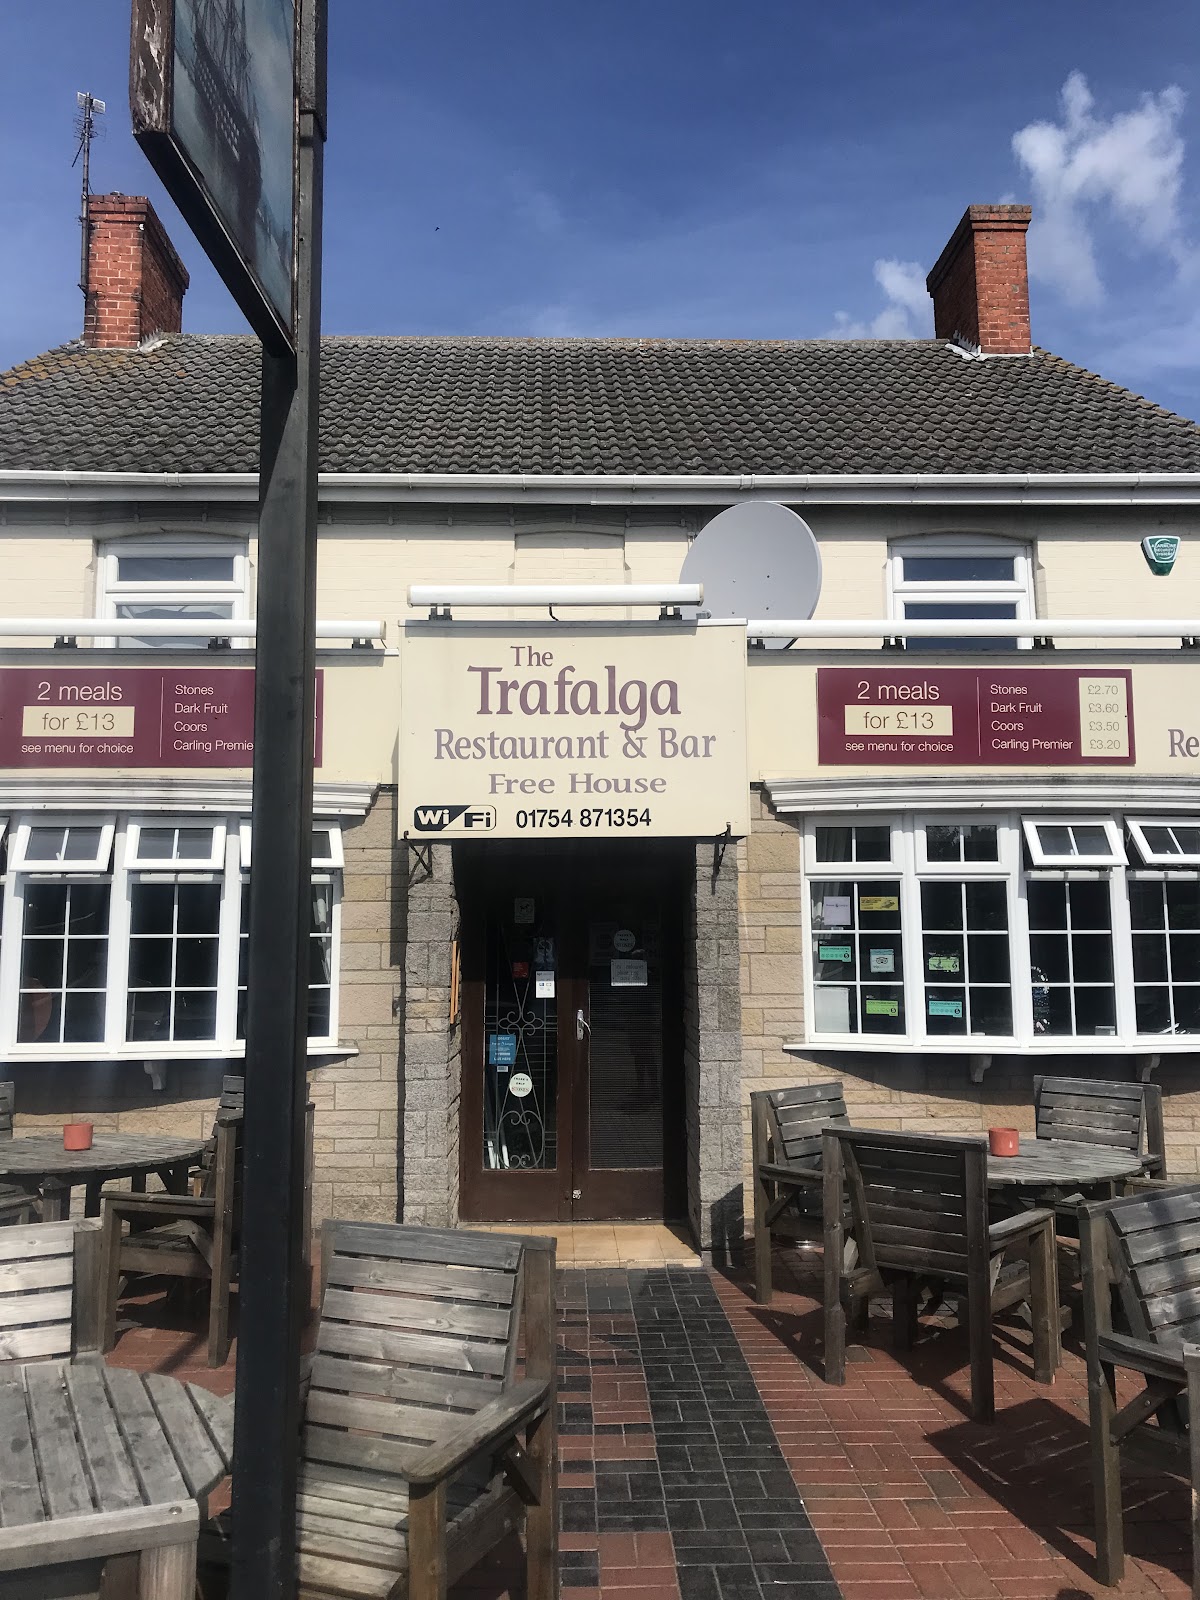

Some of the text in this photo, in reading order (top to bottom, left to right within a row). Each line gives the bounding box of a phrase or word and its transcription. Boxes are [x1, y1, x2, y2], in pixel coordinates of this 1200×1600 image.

[511, 646, 553, 666] The
[38, 681, 122, 700] 2 meals
[175, 685, 214, 694] Stones
[858, 681, 939, 699] 2 meals
[991, 684, 1118, 695] Stones £2.70
[467, 665, 680, 731] Trafalga
[175, 703, 228, 713] Dark Fruit
[991, 702, 1119, 713] Dark Fruit £3.60
[42, 713, 115, 730] for £13
[174, 722, 207, 732] Coors
[864, 712, 934, 729] for £13
[992, 721, 1119, 731] Coors £3.50
[22, 743, 133, 753] see menu for choice
[174, 740, 254, 752] Carling Premie
[434, 727, 716, 759] Restaurant & Bar
[846, 741, 953, 751] see menu for choice
[992, 739, 1120, 751] Carling Premier £3.20
[1168, 728, 1200, 757] Re
[489, 773, 667, 794] Free House
[516, 808, 651, 827] 01754 871354
